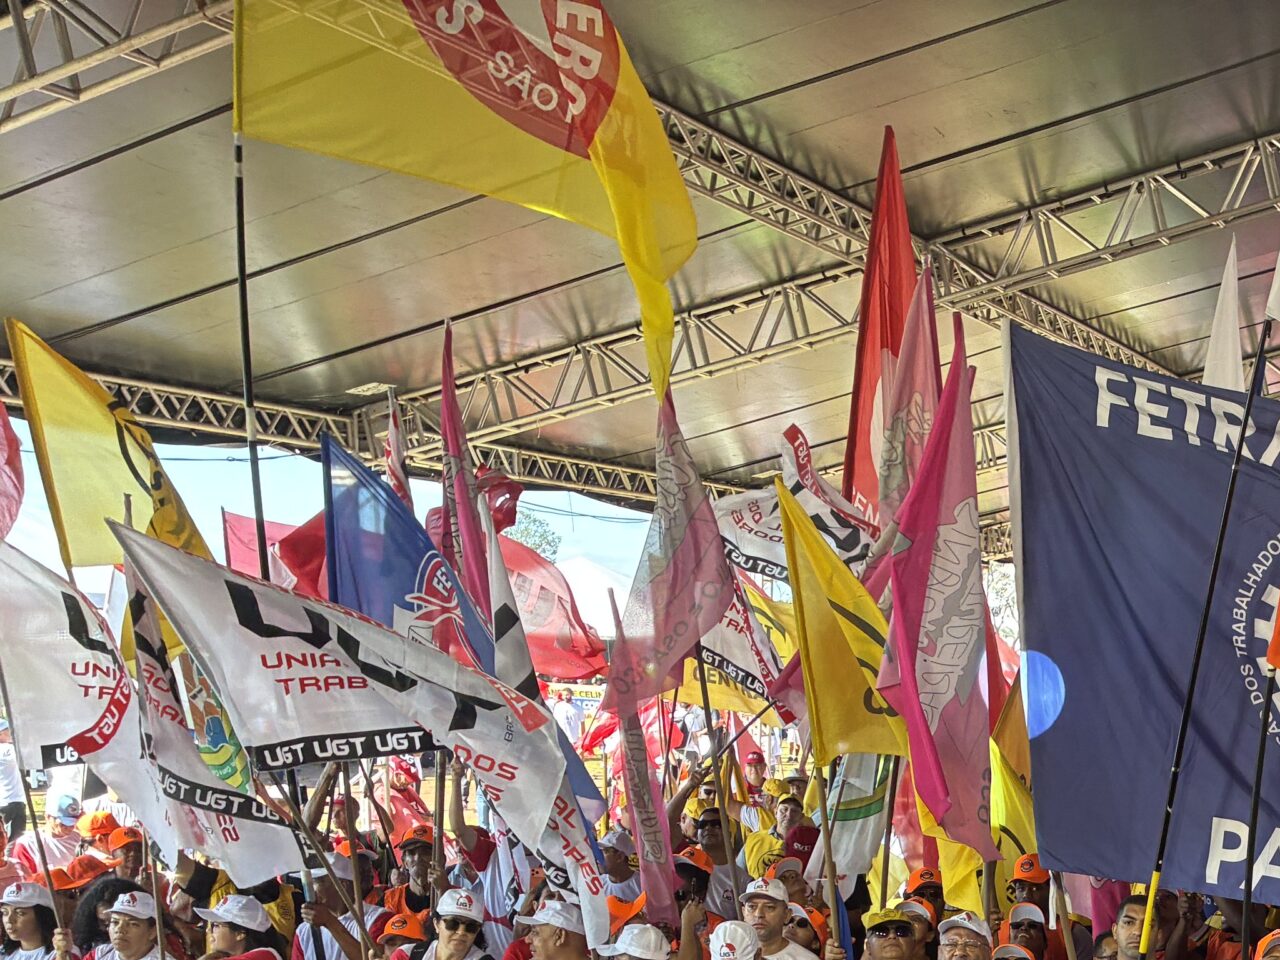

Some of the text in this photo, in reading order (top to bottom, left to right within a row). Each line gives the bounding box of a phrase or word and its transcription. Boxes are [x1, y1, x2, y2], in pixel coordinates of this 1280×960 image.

[487, 51, 558, 111] SÃO
[264, 731, 424, 766] UGT UGT UGT
[195, 790, 245, 814] UGT
